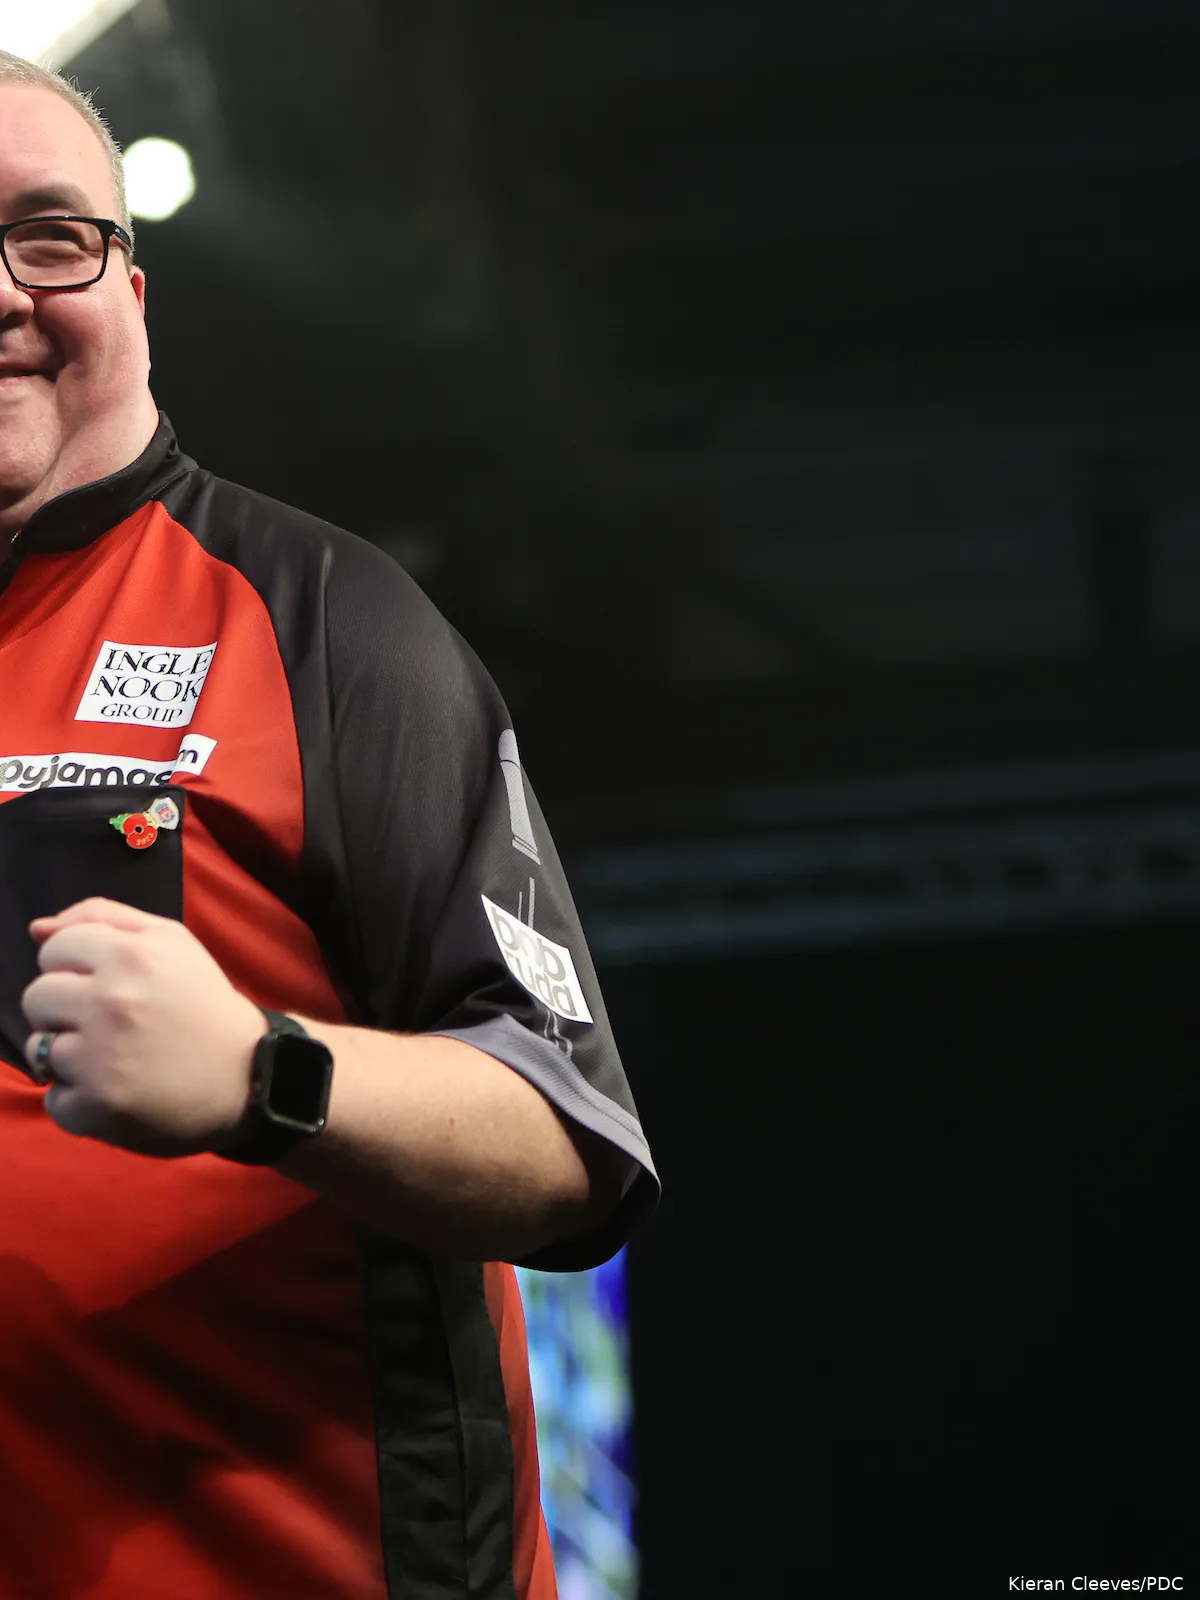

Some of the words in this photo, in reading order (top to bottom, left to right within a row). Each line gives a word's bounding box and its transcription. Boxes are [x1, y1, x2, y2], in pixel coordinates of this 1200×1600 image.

[102, 648, 213, 676] INGLE
[90, 675, 203, 702] NOOK
[100, 702, 183, 723] GROUP
